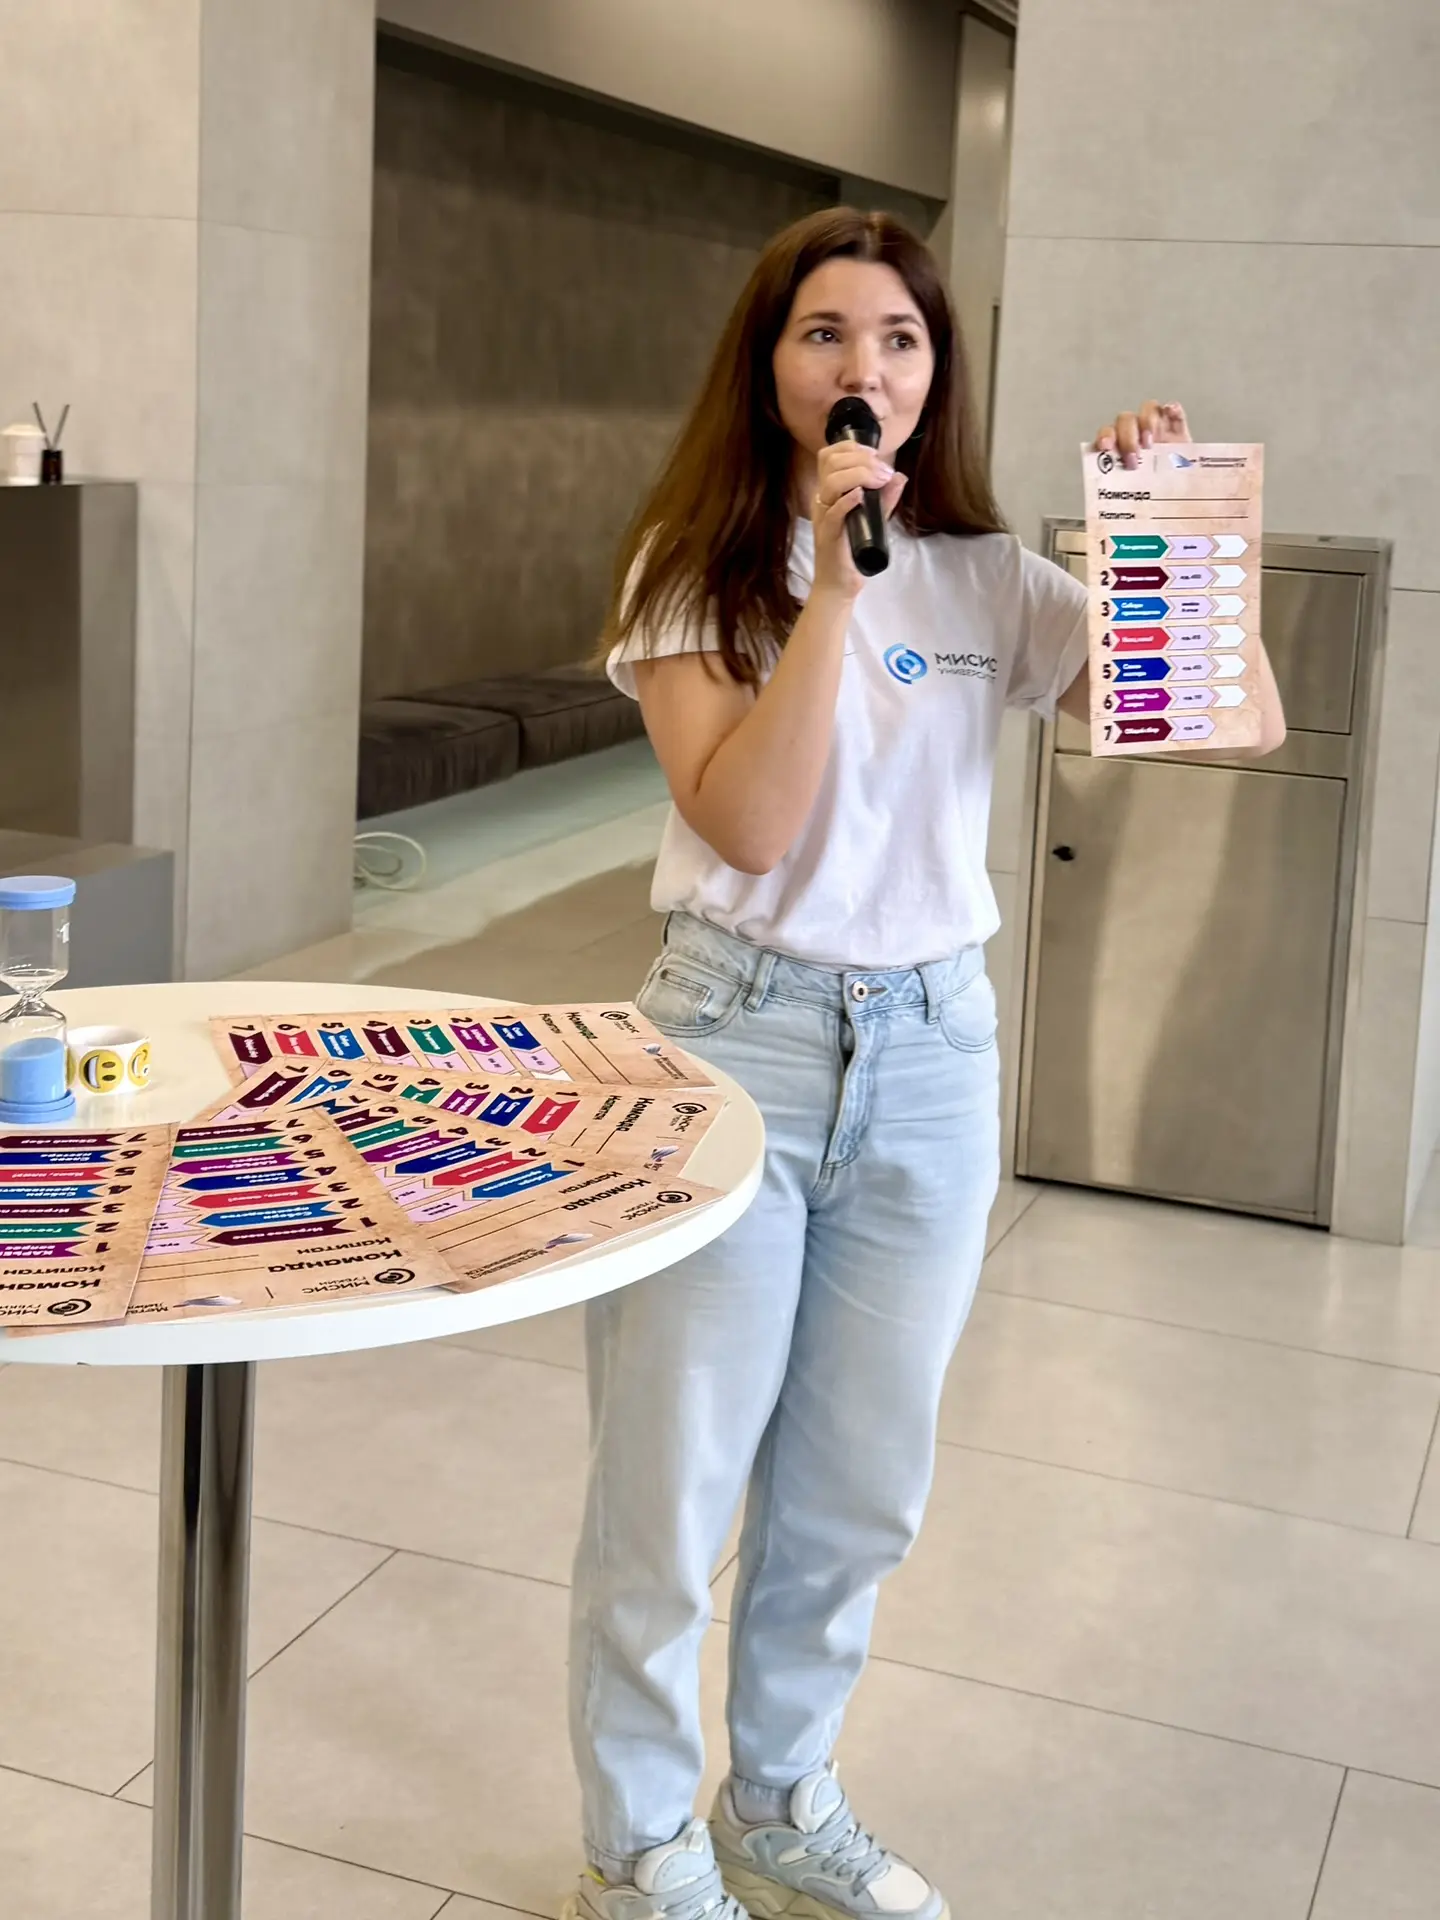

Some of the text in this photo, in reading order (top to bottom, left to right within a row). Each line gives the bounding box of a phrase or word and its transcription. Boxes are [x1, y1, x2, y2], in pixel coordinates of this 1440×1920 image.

[1098, 488, 1151, 501] Команда
[1100, 539, 1106, 555] 1
[1101, 570, 1109, 586] 2
[1101, 601, 1110, 617] 3
[1102, 633, 1111, 648] 4
[934, 652, 998, 673] МИСИС
[1103, 664, 1111, 679] 5
[1103, 694, 1113, 710] 6
[1104, 725, 1112, 741] 7
[277, 1023, 300, 1031] 6
[410, 1018, 432, 1026] 3
[285, 1065, 309, 1073] 7
[328, 1069, 350, 1077] 6
[373, 1073, 399, 1082] 5
[417, 1078, 441, 1086] 4
[465, 1082, 489, 1090] 3
[509, 1086, 533, 1094] 2
[348, 1095, 371, 1104] 7
[378, 1106, 399, 1114] 6
[286, 1119, 305, 1128] 7
[411, 1116, 438, 1125] 5
[447, 1127, 469, 1135] 4
[127, 1133, 147, 1142] 7
[291, 1134, 313, 1144] 6
[485, 1137, 511, 1146] 3
[120, 1150, 142, 1159] 6
[303, 1149, 326, 1159] 5
[518, 1147, 547, 1157] 2
[561, 1159, 585, 1167] 1
[114, 1166, 137, 1177] 5
[314, 1166, 337, 1176] 4
[108, 1185, 132, 1195] 4
[327, 1182, 351, 1192] 3
[561, 1178, 652, 1211] Команда
[102, 1203, 126, 1213] 3
[338, 1198, 364, 1209] 2
[95, 1222, 120, 1233] 2
[360, 1217, 378, 1228] 1
[95, 1242, 111, 1254] 1
[296, 1236, 393, 1255] Капитан
[267, 1249, 402, 1273] Команда
[3, 1265, 106, 1276] Капитан
[302, 1280, 371, 1294] МИСИС
